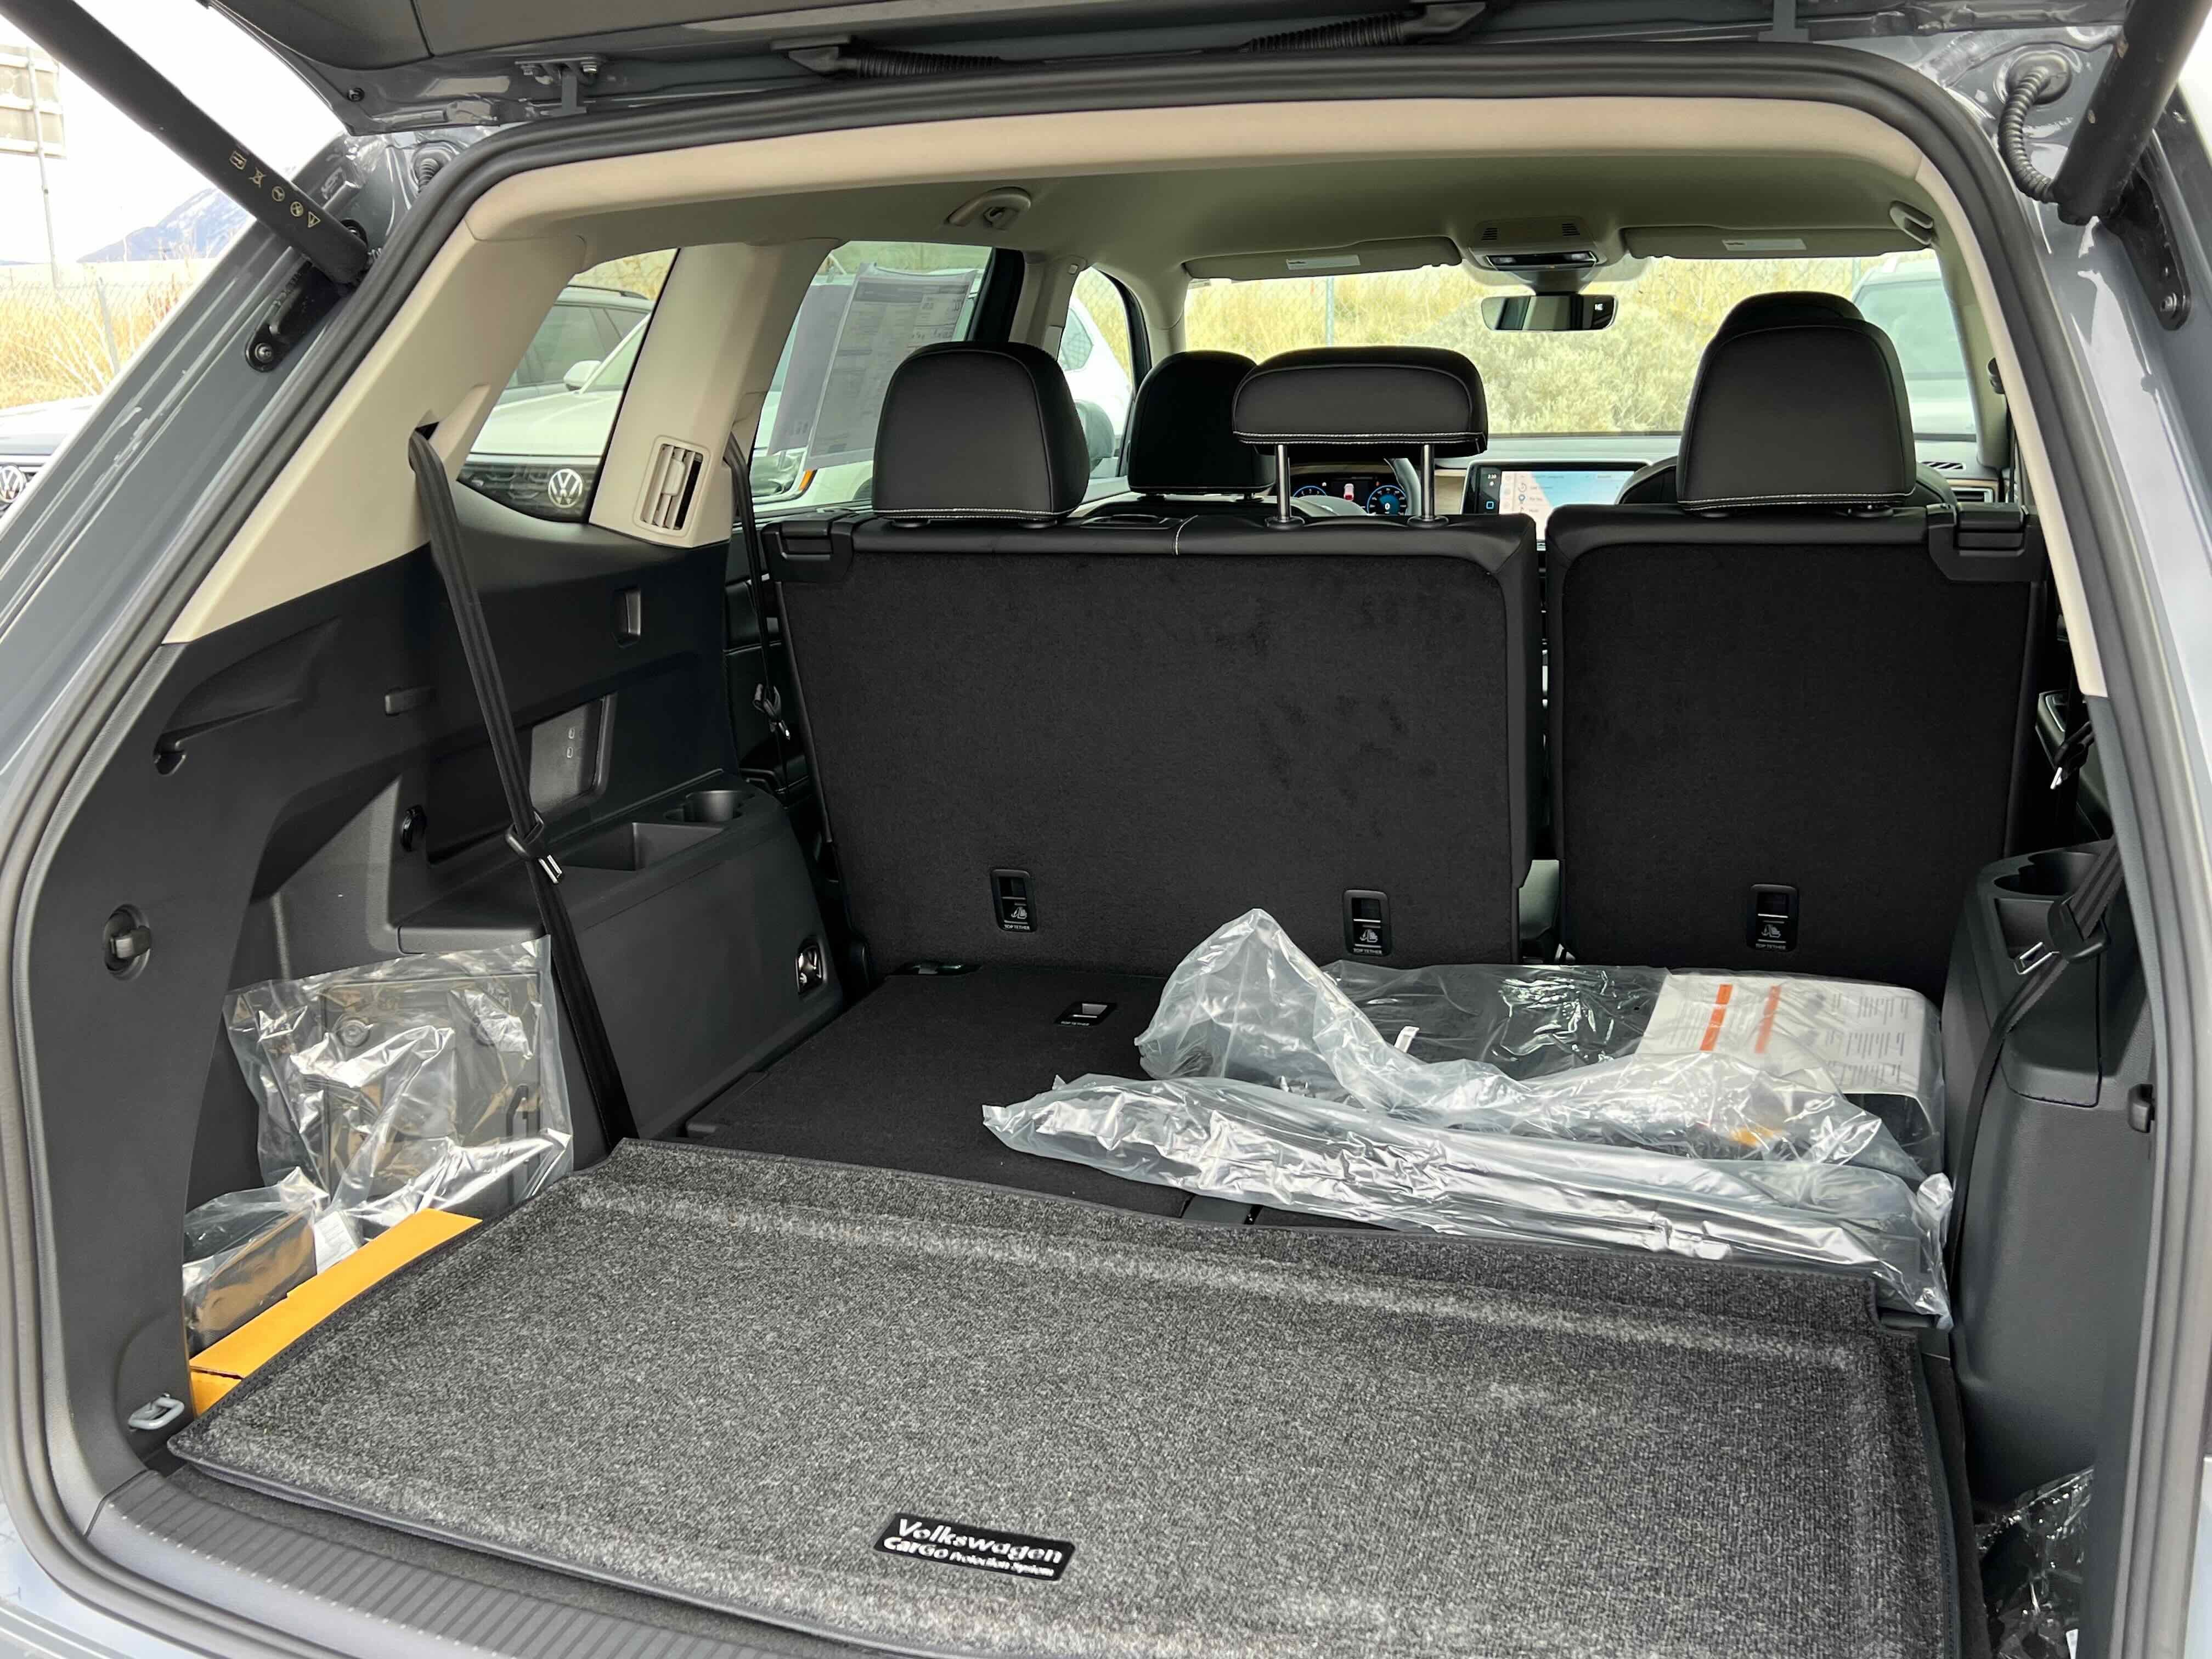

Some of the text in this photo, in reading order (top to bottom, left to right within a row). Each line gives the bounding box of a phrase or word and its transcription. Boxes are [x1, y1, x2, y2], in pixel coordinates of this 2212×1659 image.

[548, 469, 583, 509] VW
[899, 1518, 1063, 1564] Volkswagen
[949, 1551, 1010, 1570] Protection
